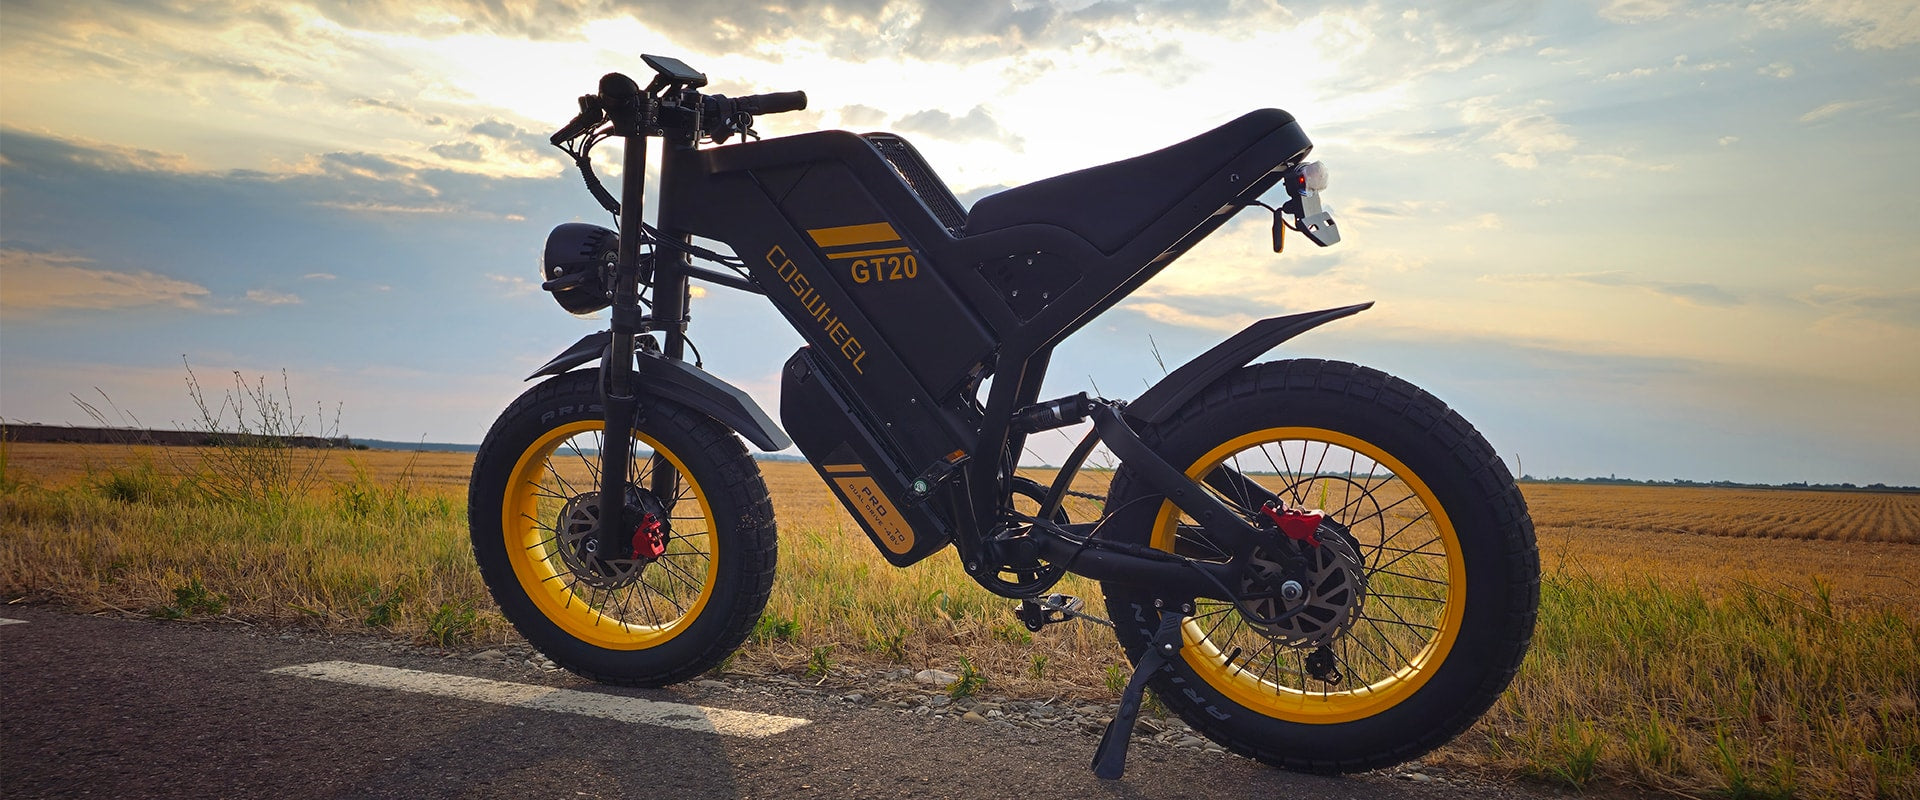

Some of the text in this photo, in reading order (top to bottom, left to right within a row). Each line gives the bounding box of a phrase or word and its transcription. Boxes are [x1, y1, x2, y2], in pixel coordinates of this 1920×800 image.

[851, 254, 918, 284] GT20
[765, 244, 866, 375] COSWHEEL
[540, 403, 647, 425] ARIS
[848, 483, 864, 504] DUAL
[865, 504, 884, 526] DRIVE
[861, 486, 887, 517] PRO
